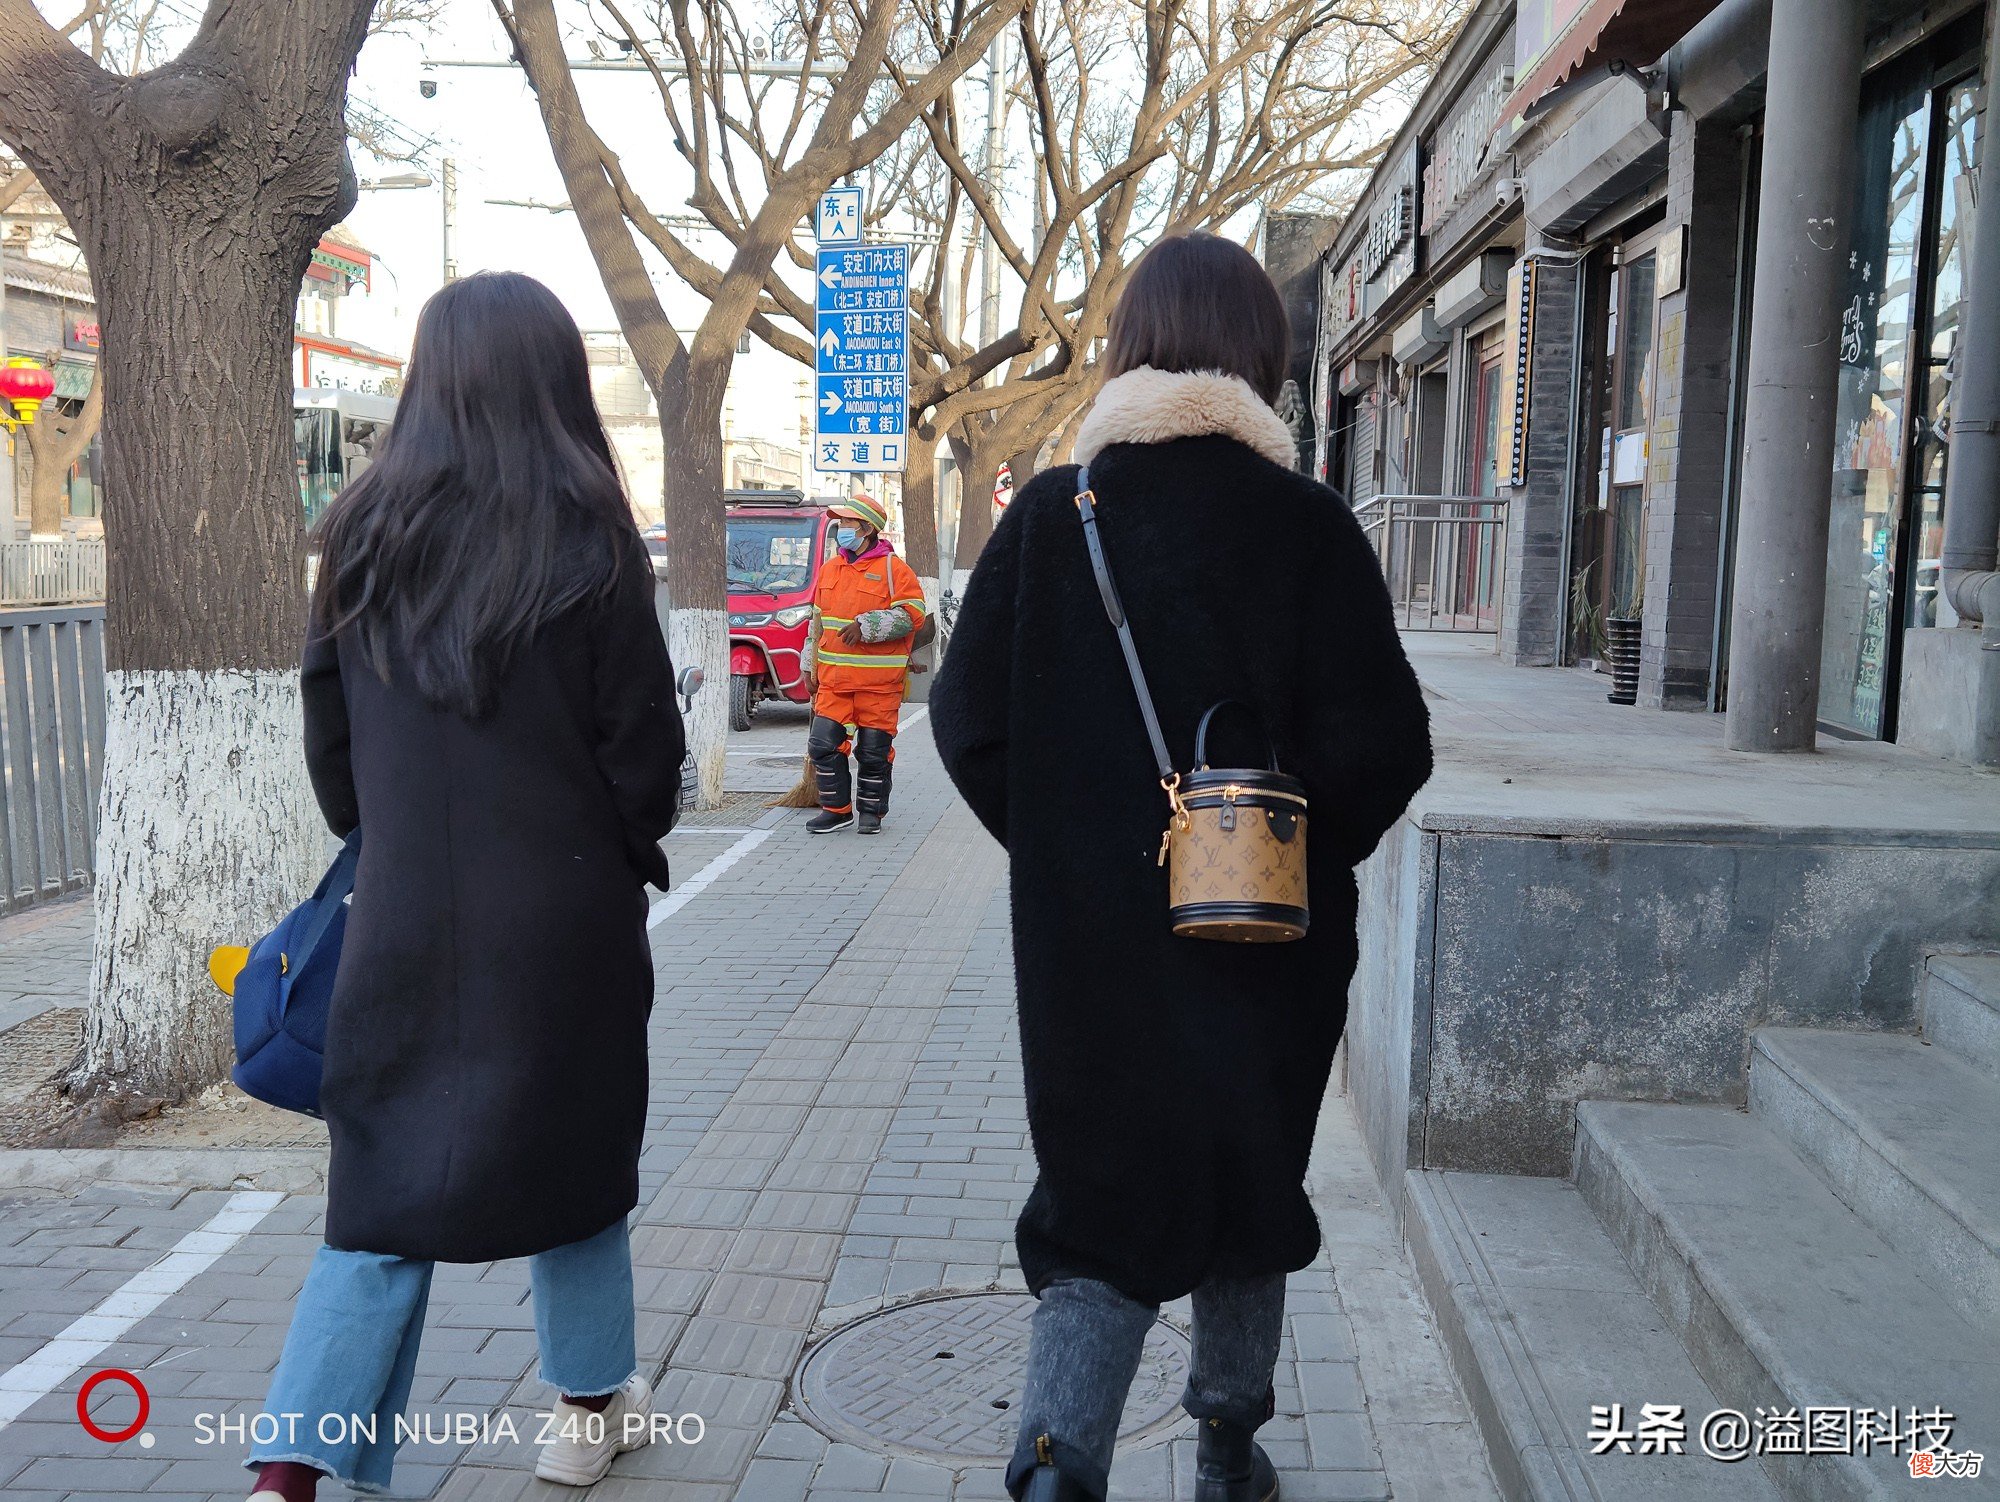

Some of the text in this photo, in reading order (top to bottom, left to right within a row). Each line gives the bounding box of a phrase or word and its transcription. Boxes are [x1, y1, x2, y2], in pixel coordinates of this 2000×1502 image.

[825, 196, 841, 218] 东
[847, 205, 855, 217] E
[843, 249, 904, 274] 安定门内大街
[896, 273, 904, 287] St
[843, 312, 903, 336] 交道口东大街
[844, 336, 902, 350] JIAODAOKOU East St
[843, 376, 903, 399] 交道口南大街
[879, 400, 894, 414] South
[895, 400, 902, 414] St
[822, 440, 898, 464] 交道口
